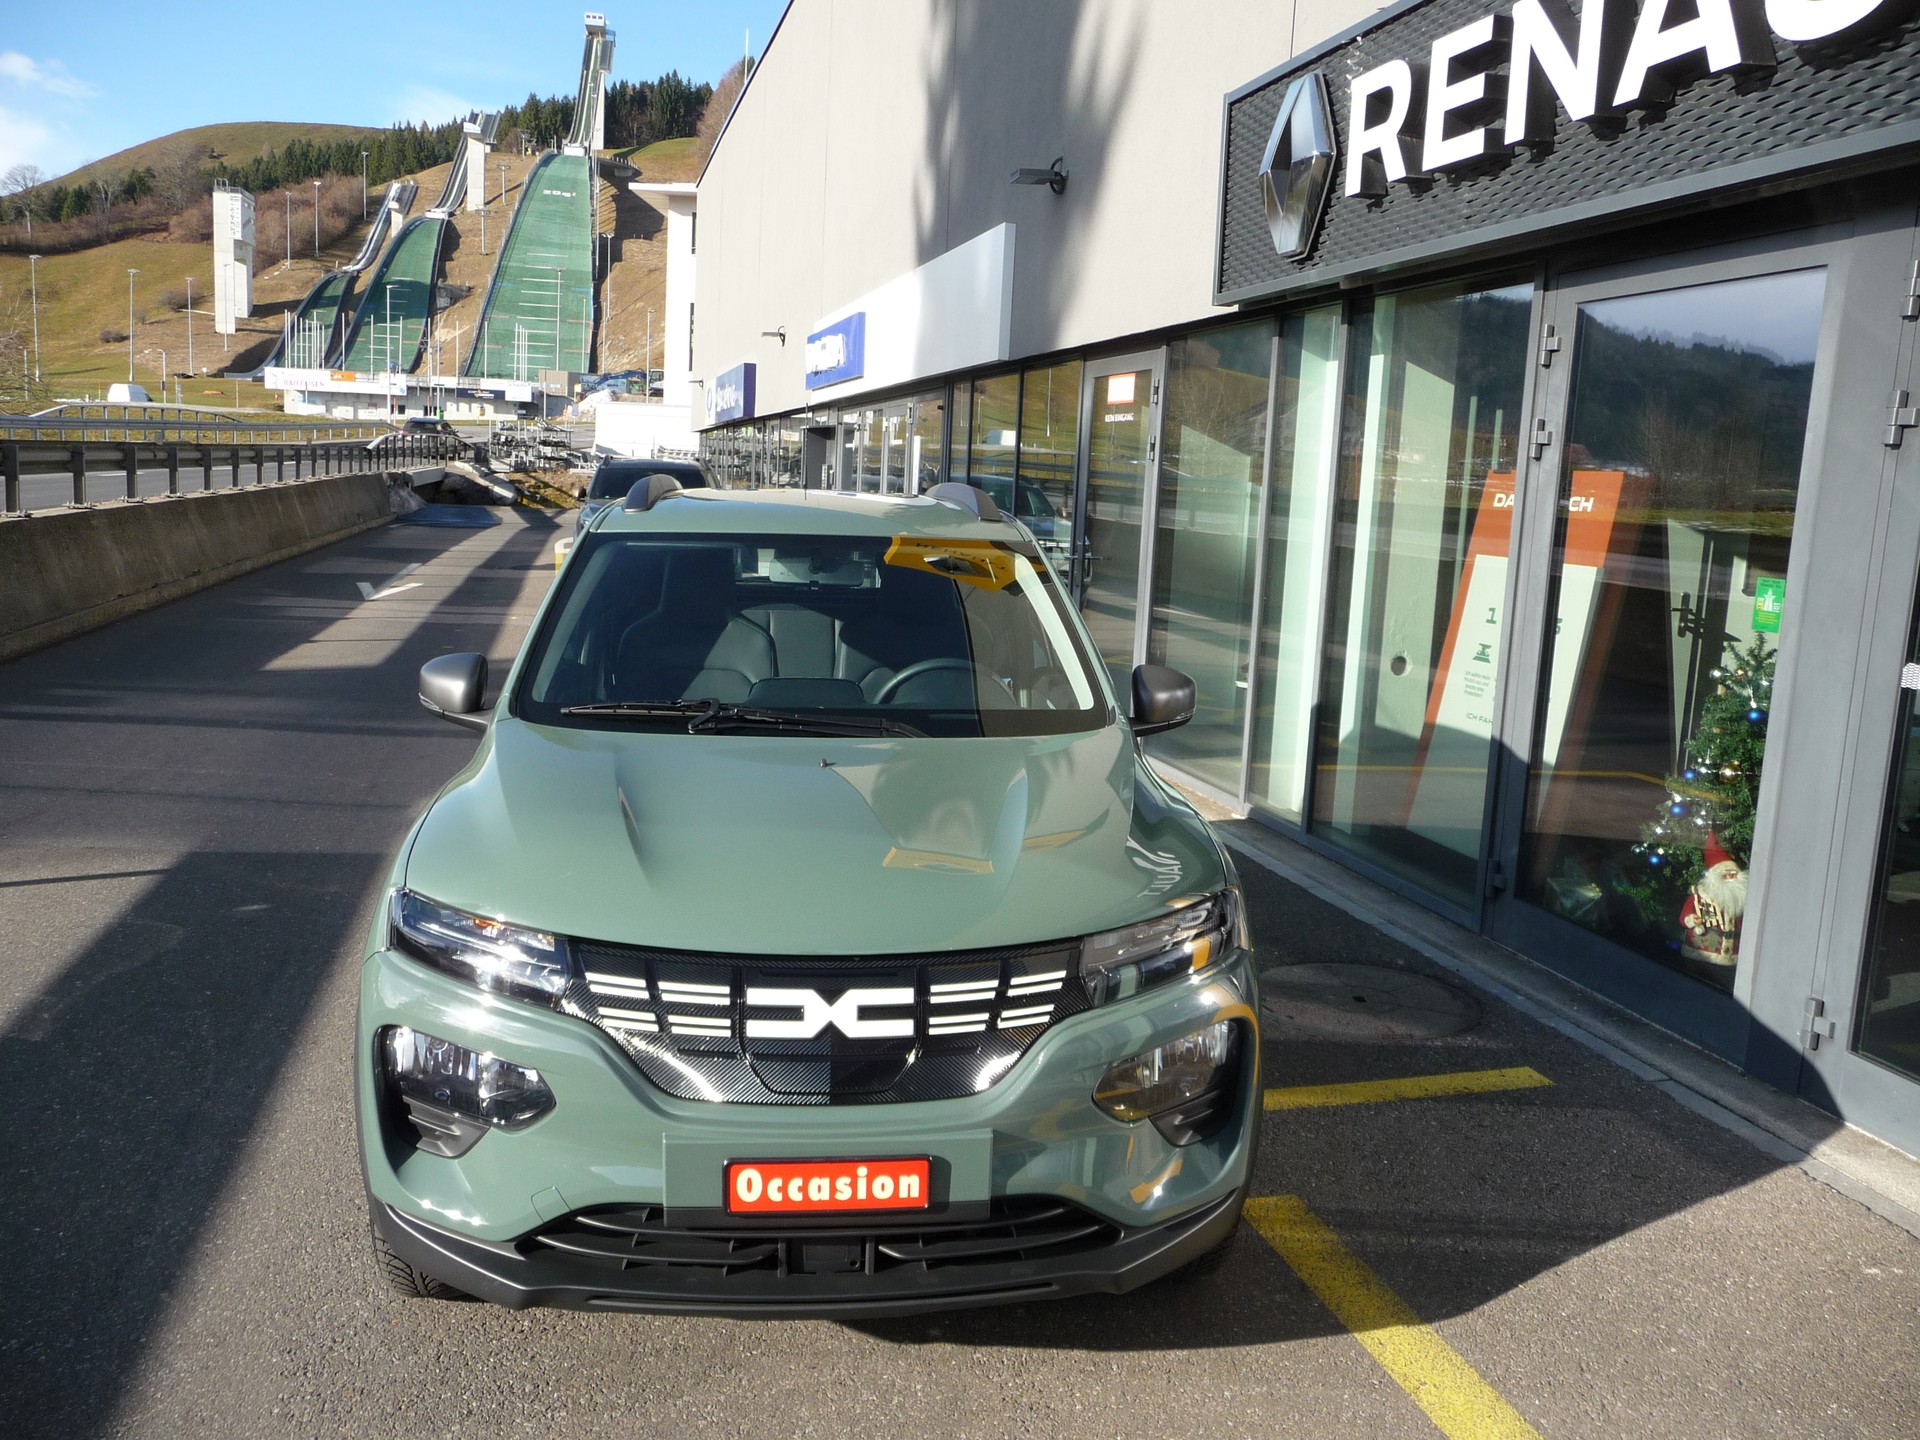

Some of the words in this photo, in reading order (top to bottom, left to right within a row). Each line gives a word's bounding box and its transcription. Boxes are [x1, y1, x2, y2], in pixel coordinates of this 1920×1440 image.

[283, 379, 325, 388] RAIFFISEN
[1493, 493, 1514, 507] DA
[1569, 496, 1594, 512] CH
[1479, 715, 1493, 725] FAH
[736, 1165, 921, 1203] Occasion
